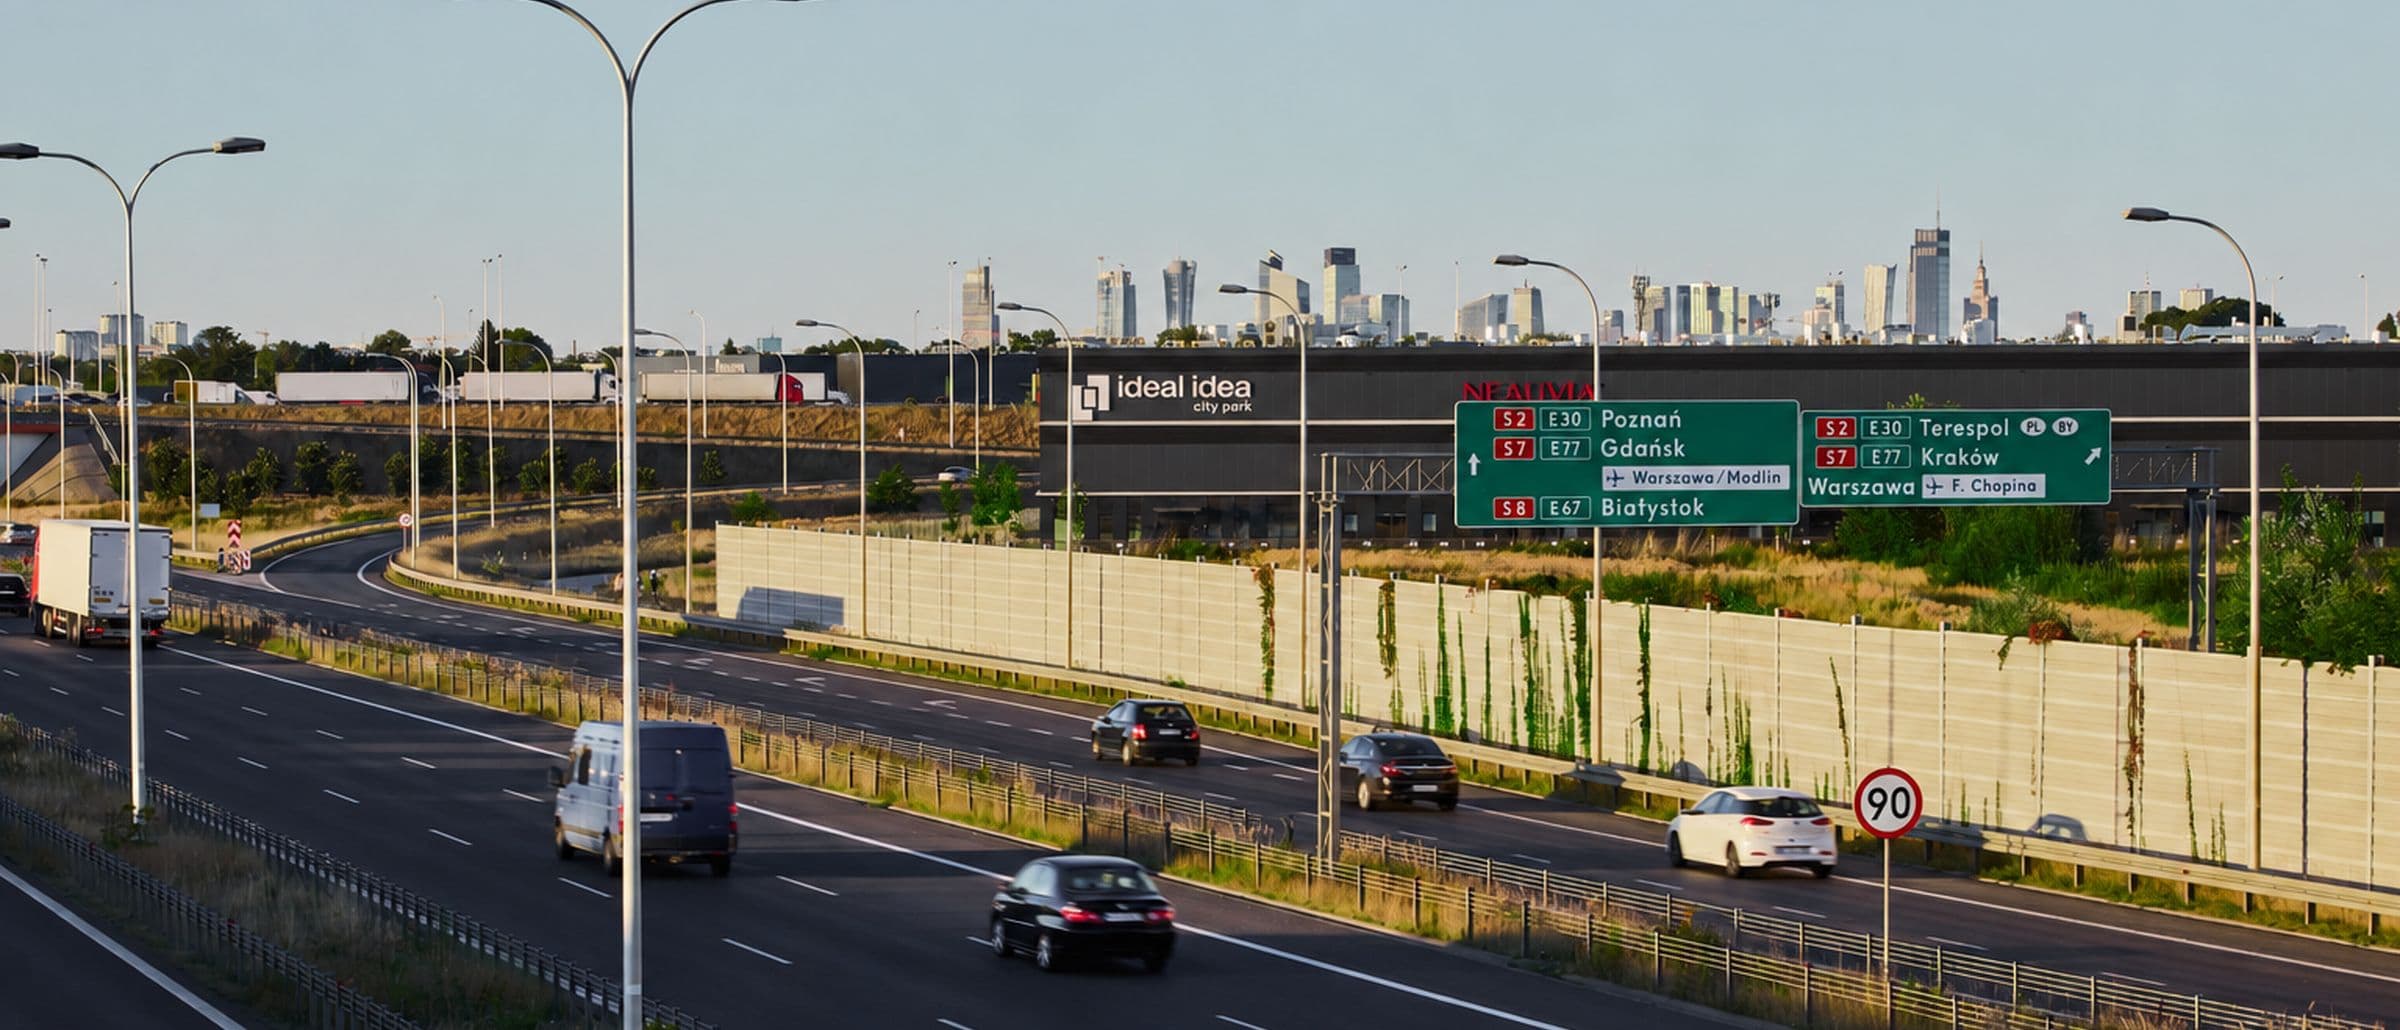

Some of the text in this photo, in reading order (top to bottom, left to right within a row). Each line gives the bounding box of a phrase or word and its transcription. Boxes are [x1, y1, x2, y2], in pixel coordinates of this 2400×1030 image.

[1118, 375, 1251, 398] ideal idea
[1194, 400, 1252, 415] city park
[1550, 411, 1582, 428] E30
[1603, 410, 1681, 429] Poznań
[1870, 421, 1902, 436] E30
[1920, 418, 2009, 441] Terespol
[2027, 421, 2041, 433] PL
[2059, 421, 2074, 433] BY
[1551, 441, 1581, 456] E77
[1601, 438, 1686, 458] Gdańsk
[1873, 449, 1901, 465] E77
[1922, 448, 1999, 466] Kraków
[1808, 478, 2037, 496] Warszawa F. Chopina
[1551, 501, 1581, 516] E67
[1602, 497, 1704, 523] Białystok
[1868, 786, 1911, 821] 90
